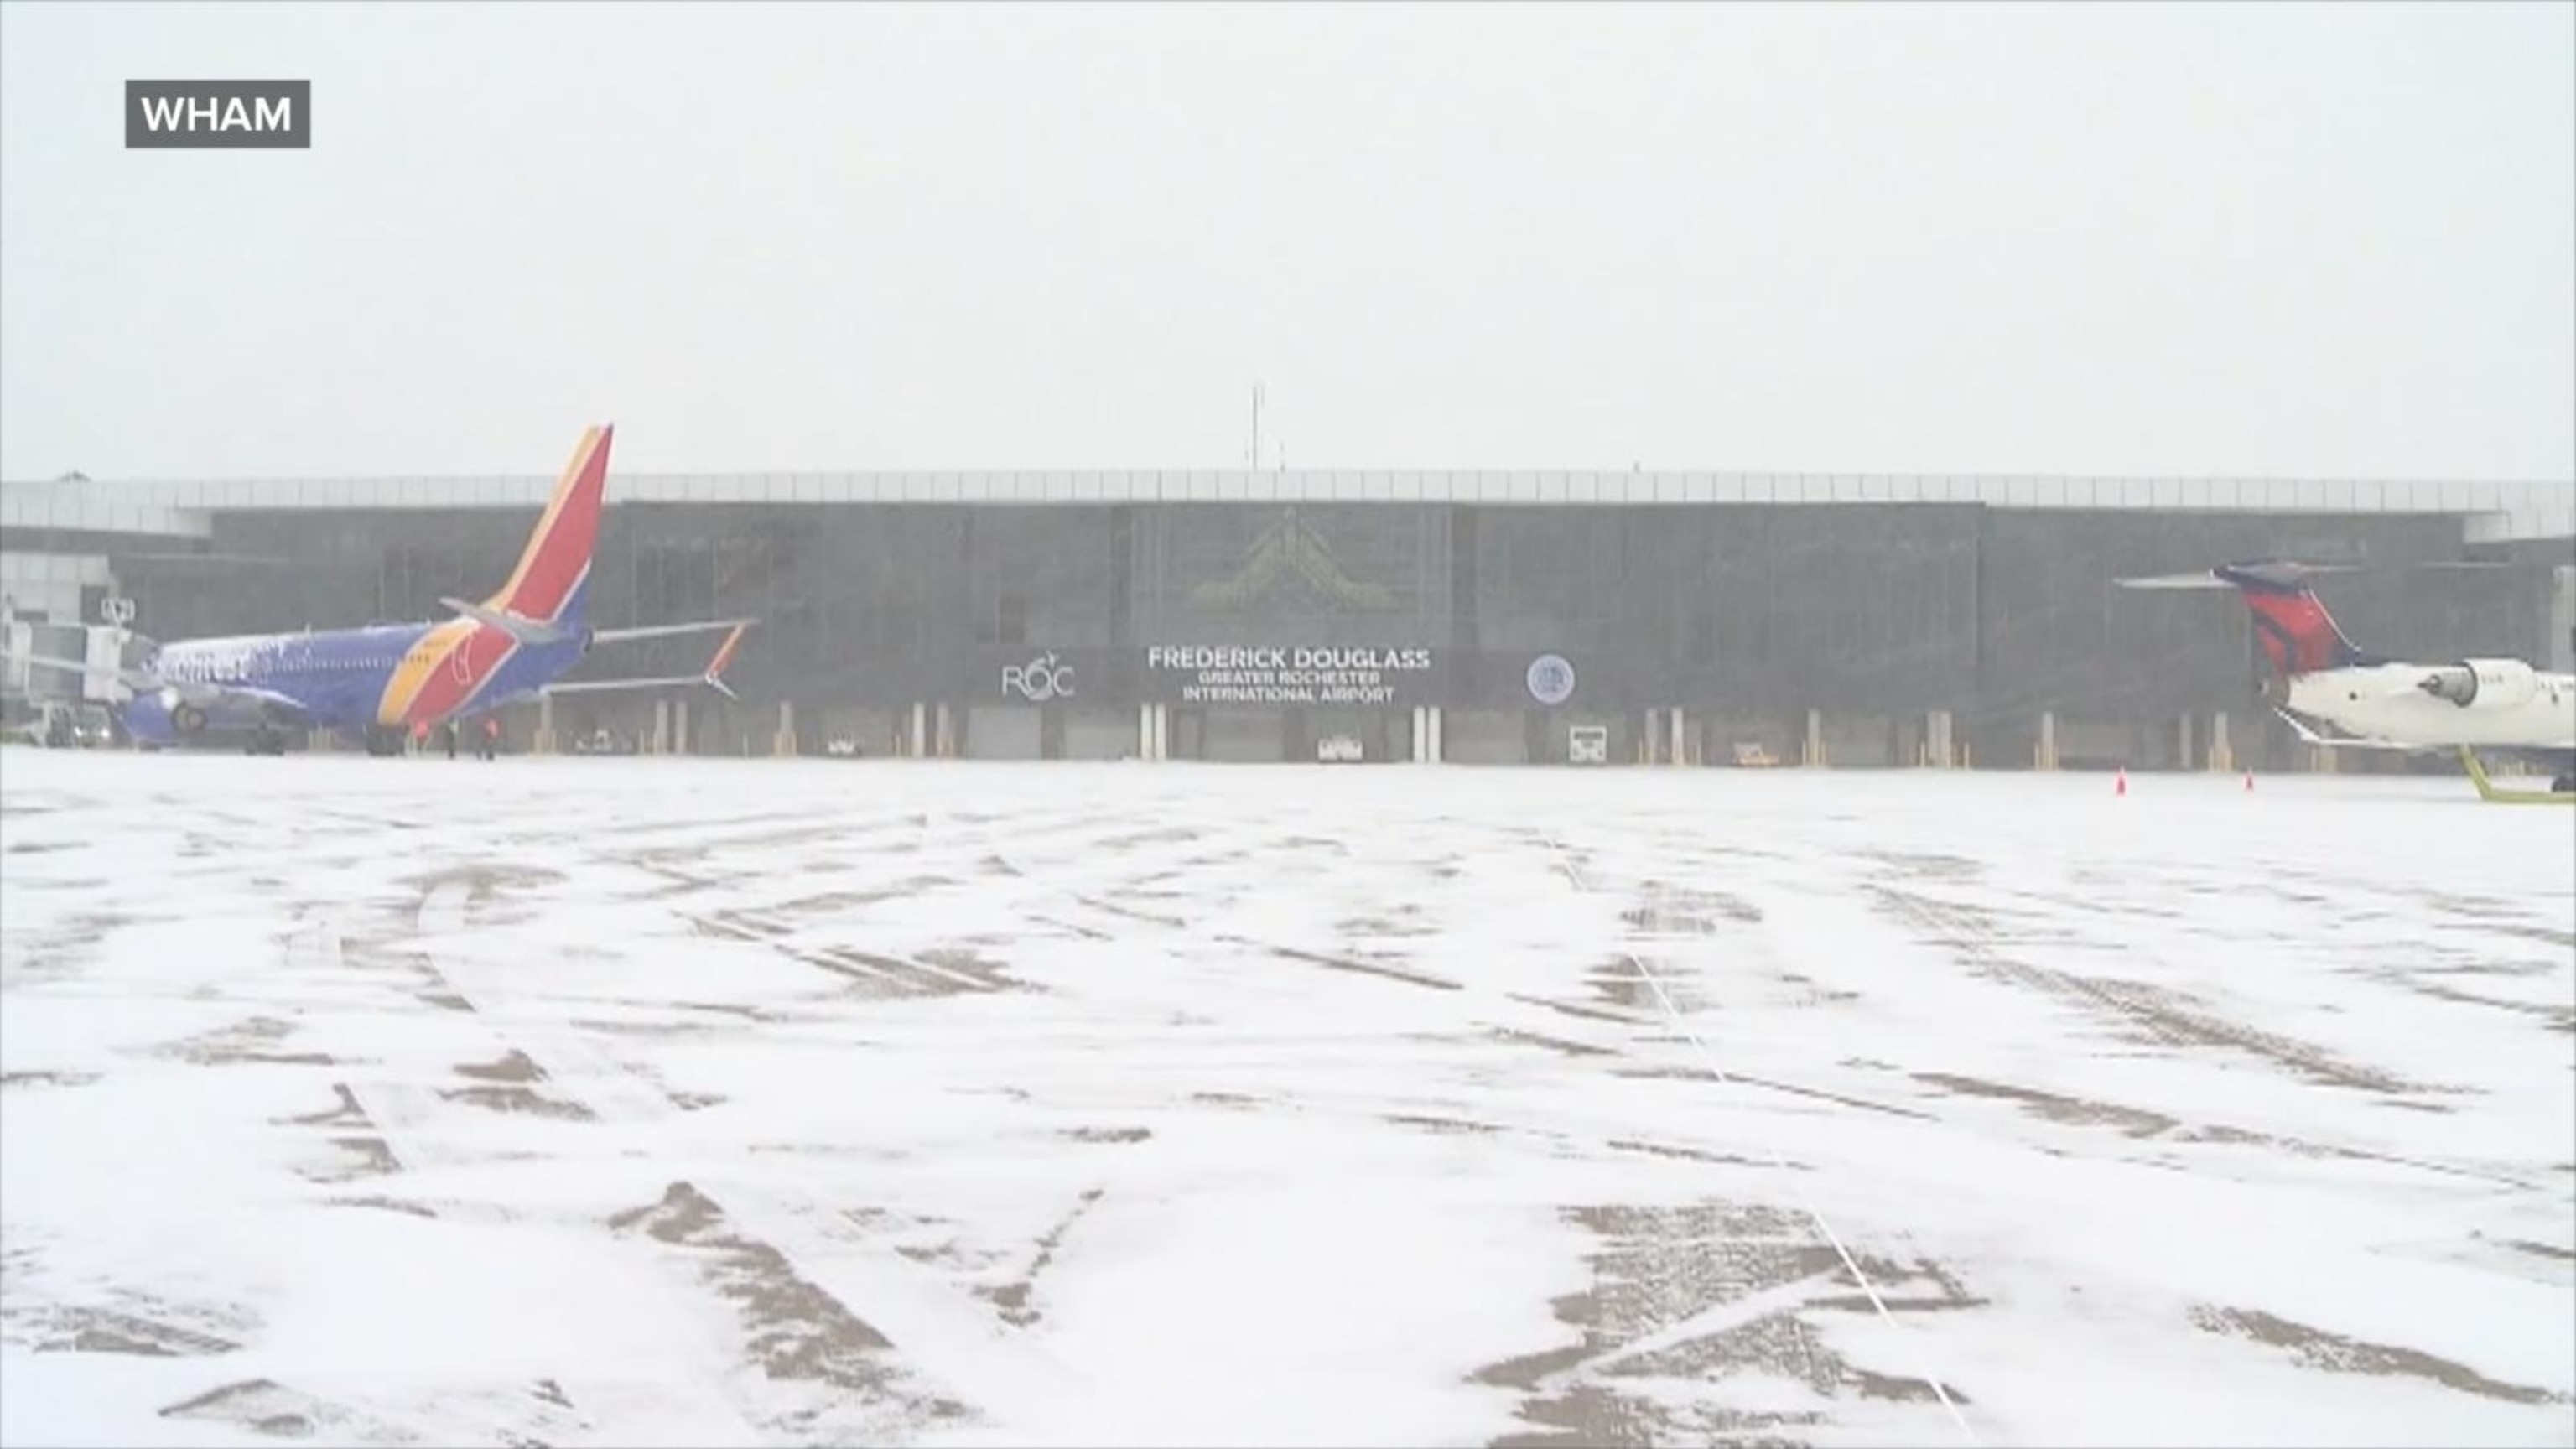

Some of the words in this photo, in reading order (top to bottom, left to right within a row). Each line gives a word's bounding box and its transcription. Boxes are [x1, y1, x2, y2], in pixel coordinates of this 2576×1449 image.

[1149, 647, 1285, 668] FREDERICK
[1294, 647, 1431, 669] DOUGLASS
[1002, 654, 1075, 700] ROC
[1198, 672, 1274, 685] GREATER
[1279, 672, 1381, 685] ROCHESTER
[1182, 687, 1313, 701] INTERNATIONAL
[1320, 688, 1394, 702] AIRPORT
